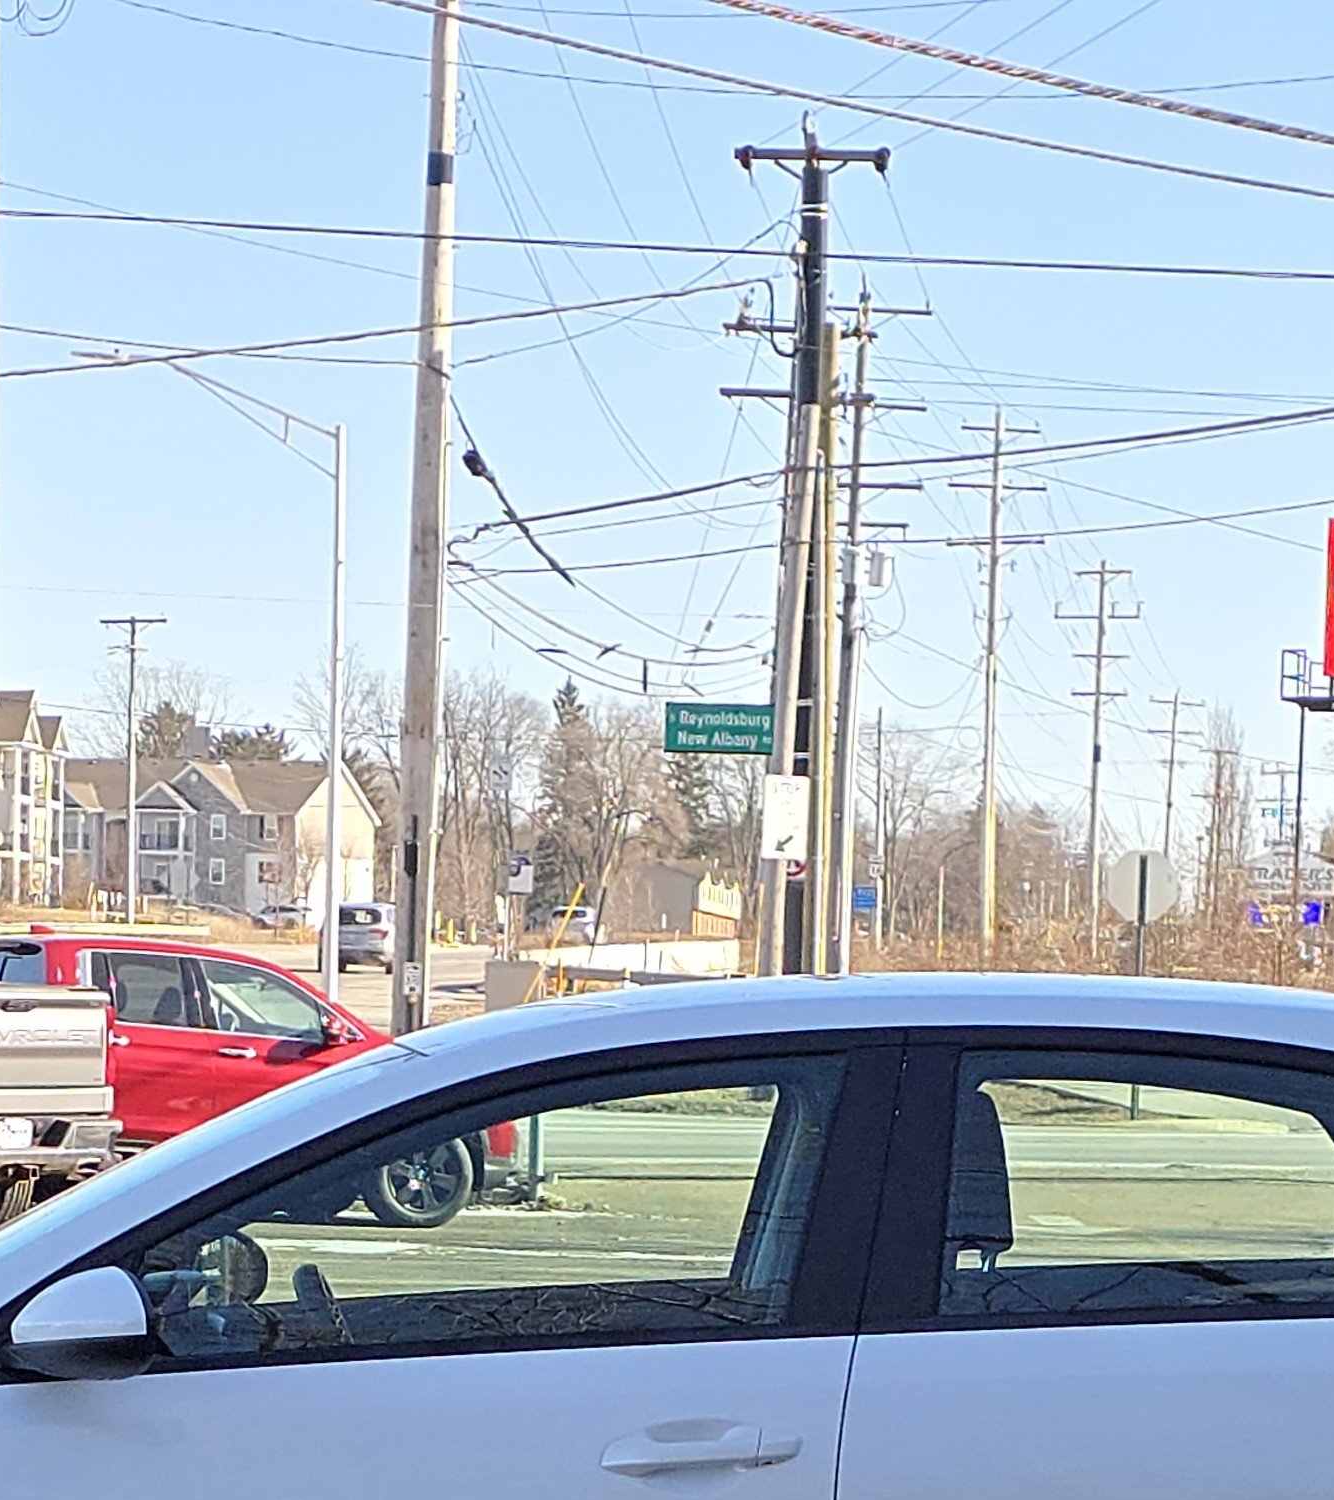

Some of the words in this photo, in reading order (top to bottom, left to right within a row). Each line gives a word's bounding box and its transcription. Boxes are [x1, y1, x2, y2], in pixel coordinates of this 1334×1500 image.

[679, 710, 771, 731] Reynoldsburg
[677, 731, 708, 746] New
[711, 731, 758, 750] Albany
